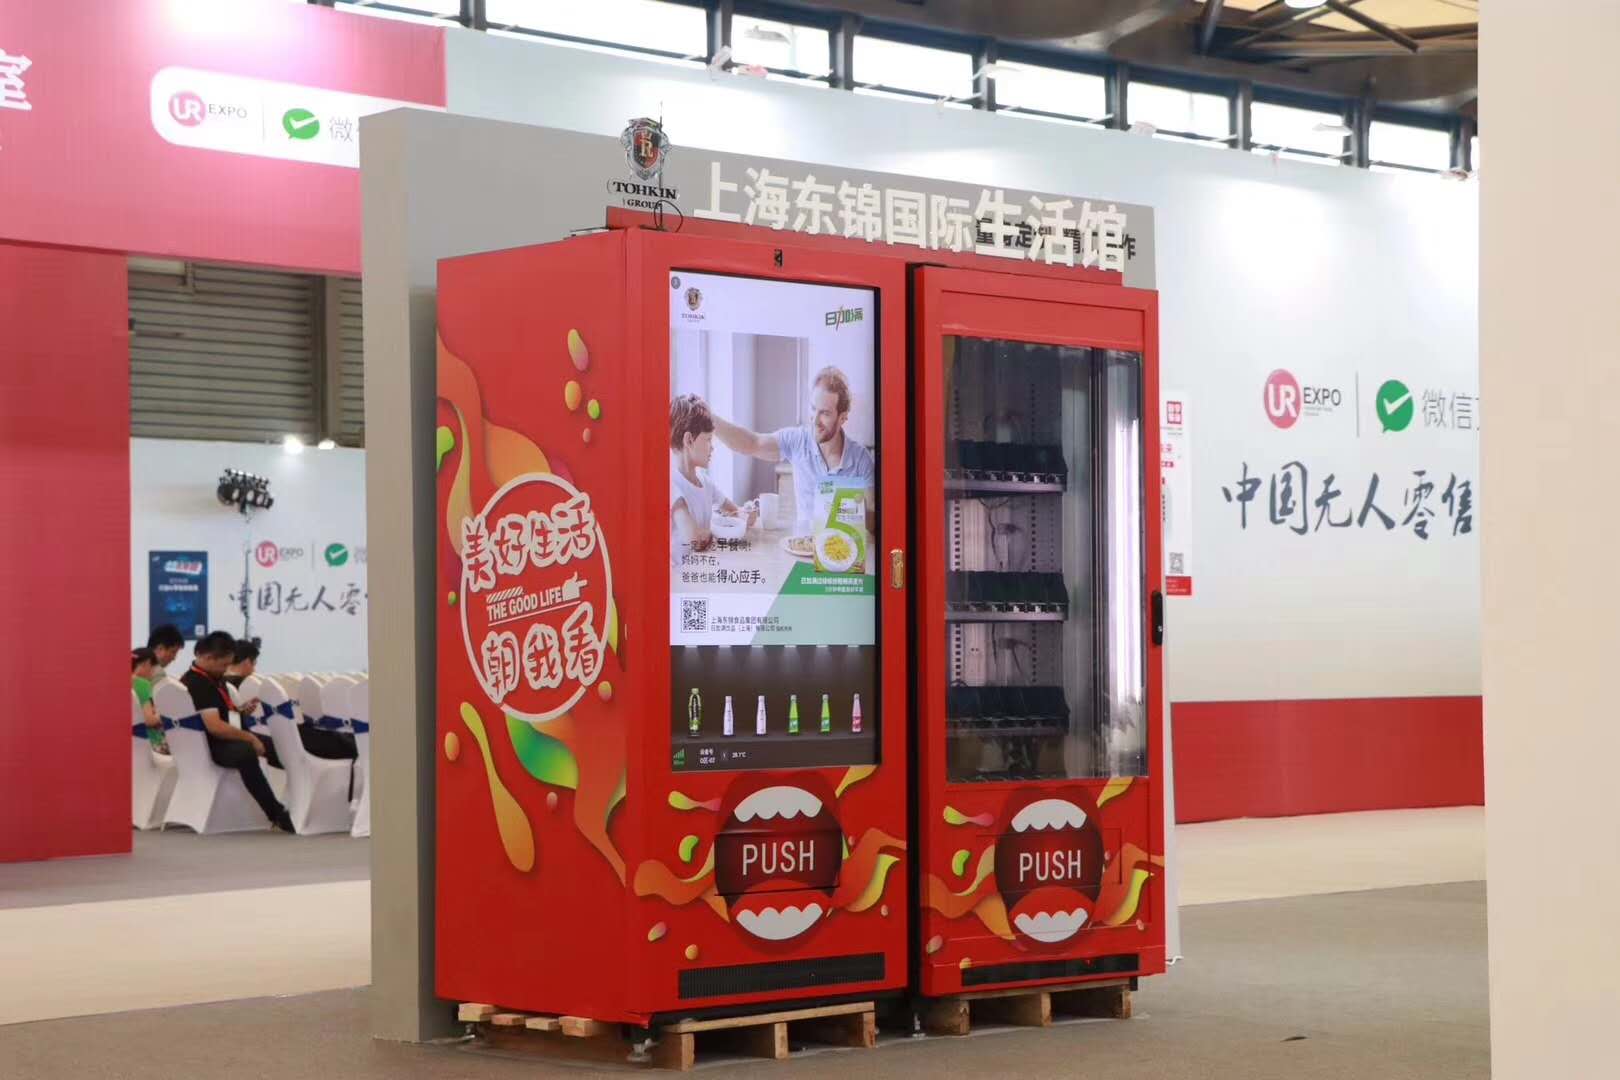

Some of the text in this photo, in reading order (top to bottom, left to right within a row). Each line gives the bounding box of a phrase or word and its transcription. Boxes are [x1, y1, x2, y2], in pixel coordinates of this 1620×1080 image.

[208, 104, 248, 120] EXPO
[328, 115, 359, 143] 微
[613, 181, 677, 200] TOHKIN
[627, 199, 662, 210] GROUP
[693, 161, 1127, 273] 上海东锦国际生活馆
[1268, 383, 1342, 418] UR EXPO
[1422, 388, 1479, 431] 微信
[1221, 460, 1474, 540] 中国无人零售
[462, 492, 596, 592] 美好生活
[229, 580, 367, 616] 中国无人零
[487, 586, 563, 621] THE GOOD LIFE
[481, 601, 601, 704] 朝我看
[742, 840, 815, 875] PUSH
[1019, 849, 1082, 882] PUSH
